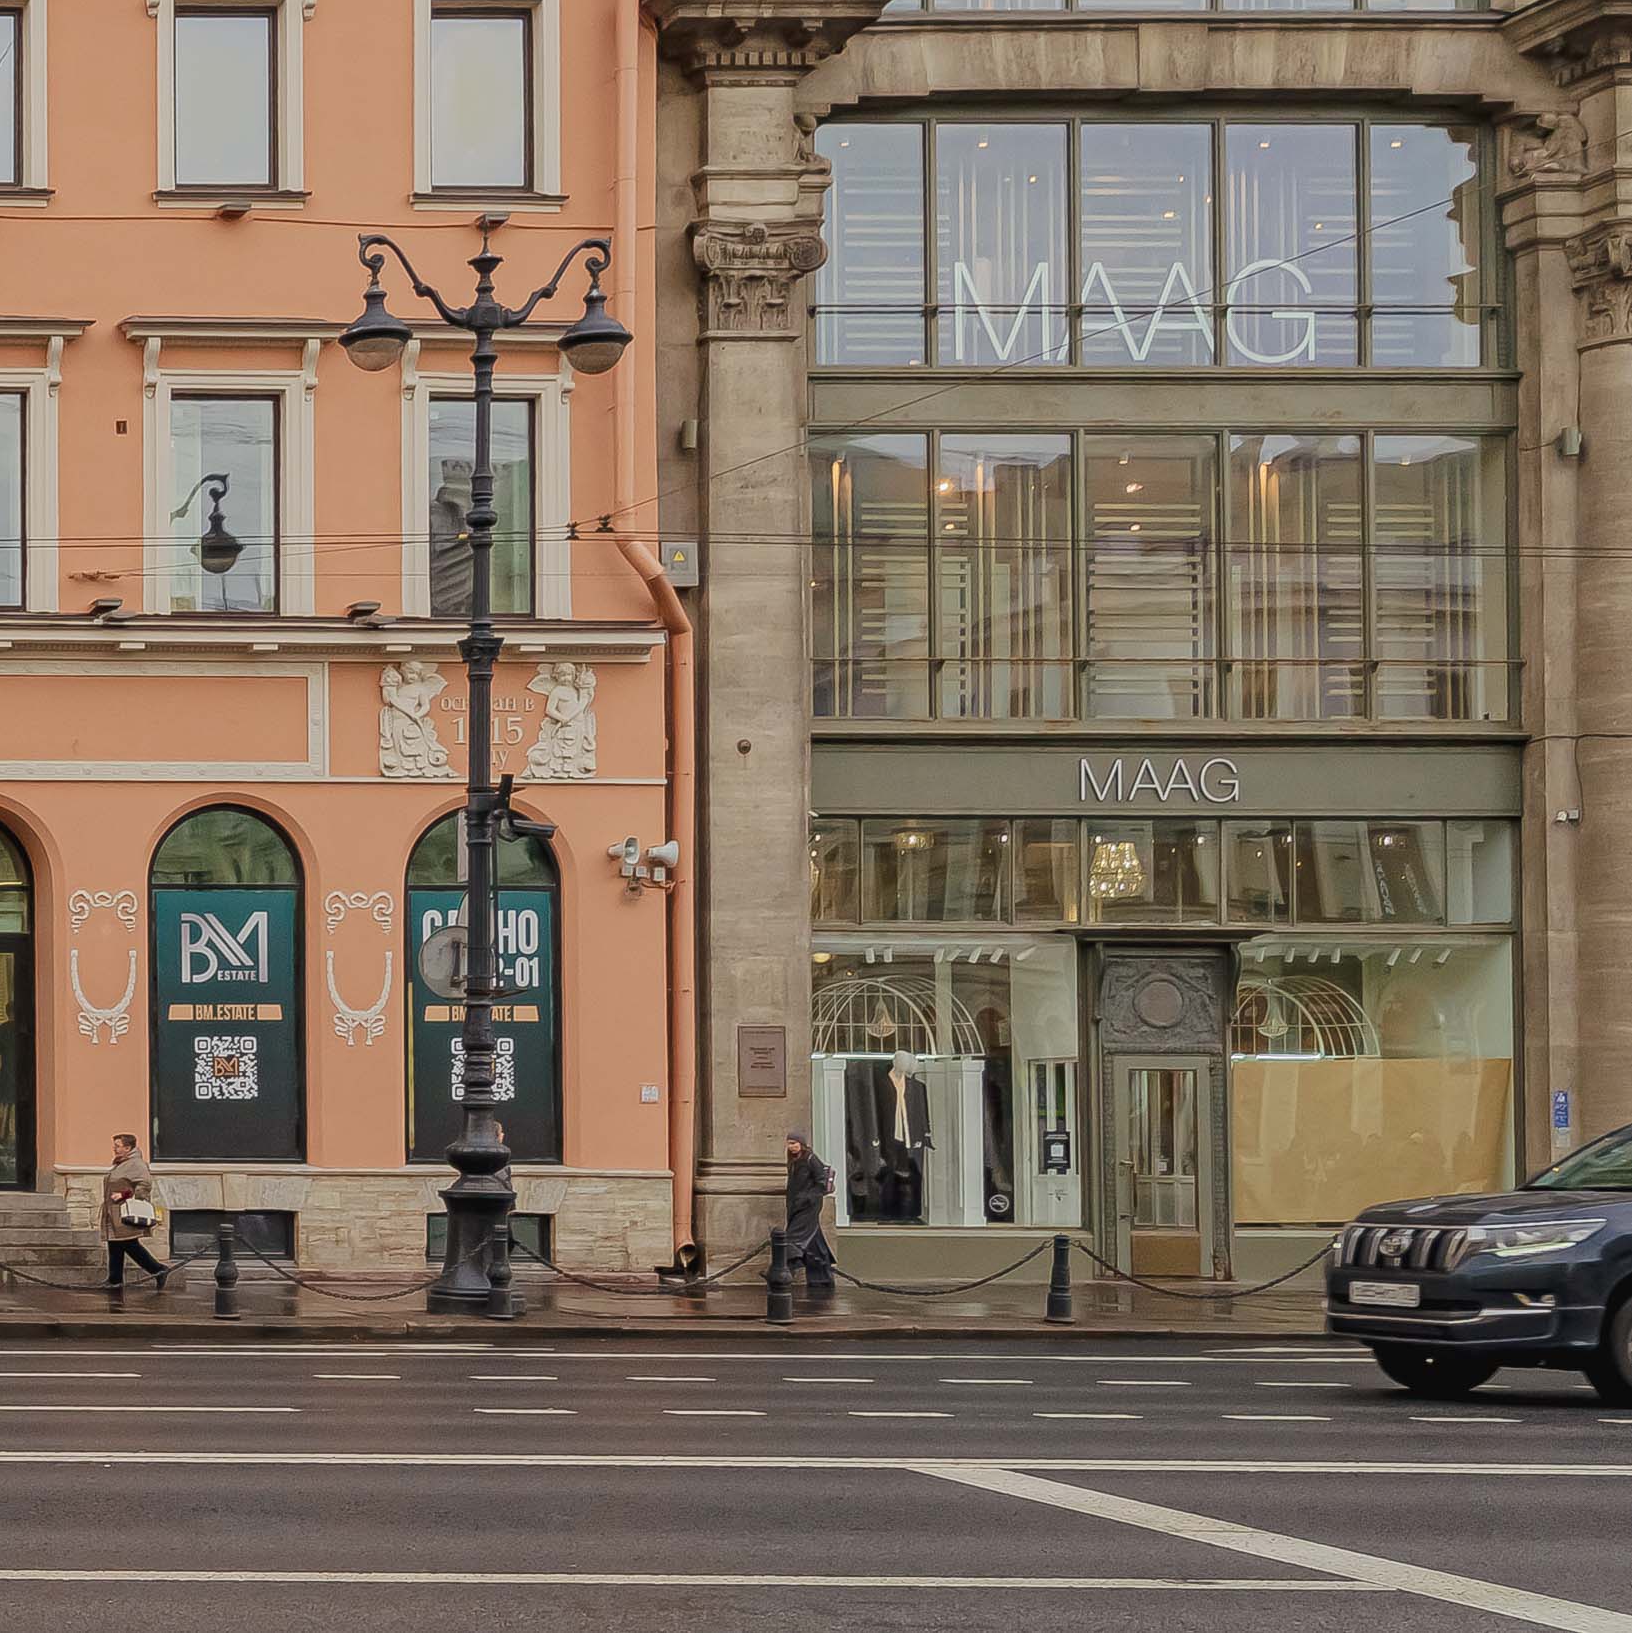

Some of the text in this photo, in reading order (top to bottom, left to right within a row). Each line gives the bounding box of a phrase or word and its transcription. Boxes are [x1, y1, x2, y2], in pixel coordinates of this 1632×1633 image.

[954, 260, 1317, 363] MAAG
[441, 696, 516, 712] осан
[452, 717, 524, 745] 115
[1079, 758, 1240, 803] MAAG
[181, 911, 268, 983] BM
[422, 909, 539, 955] СНО
[217, 970, 257, 981] ESTATE
[195, 1005, 256, 1020] BM.ESTATE
